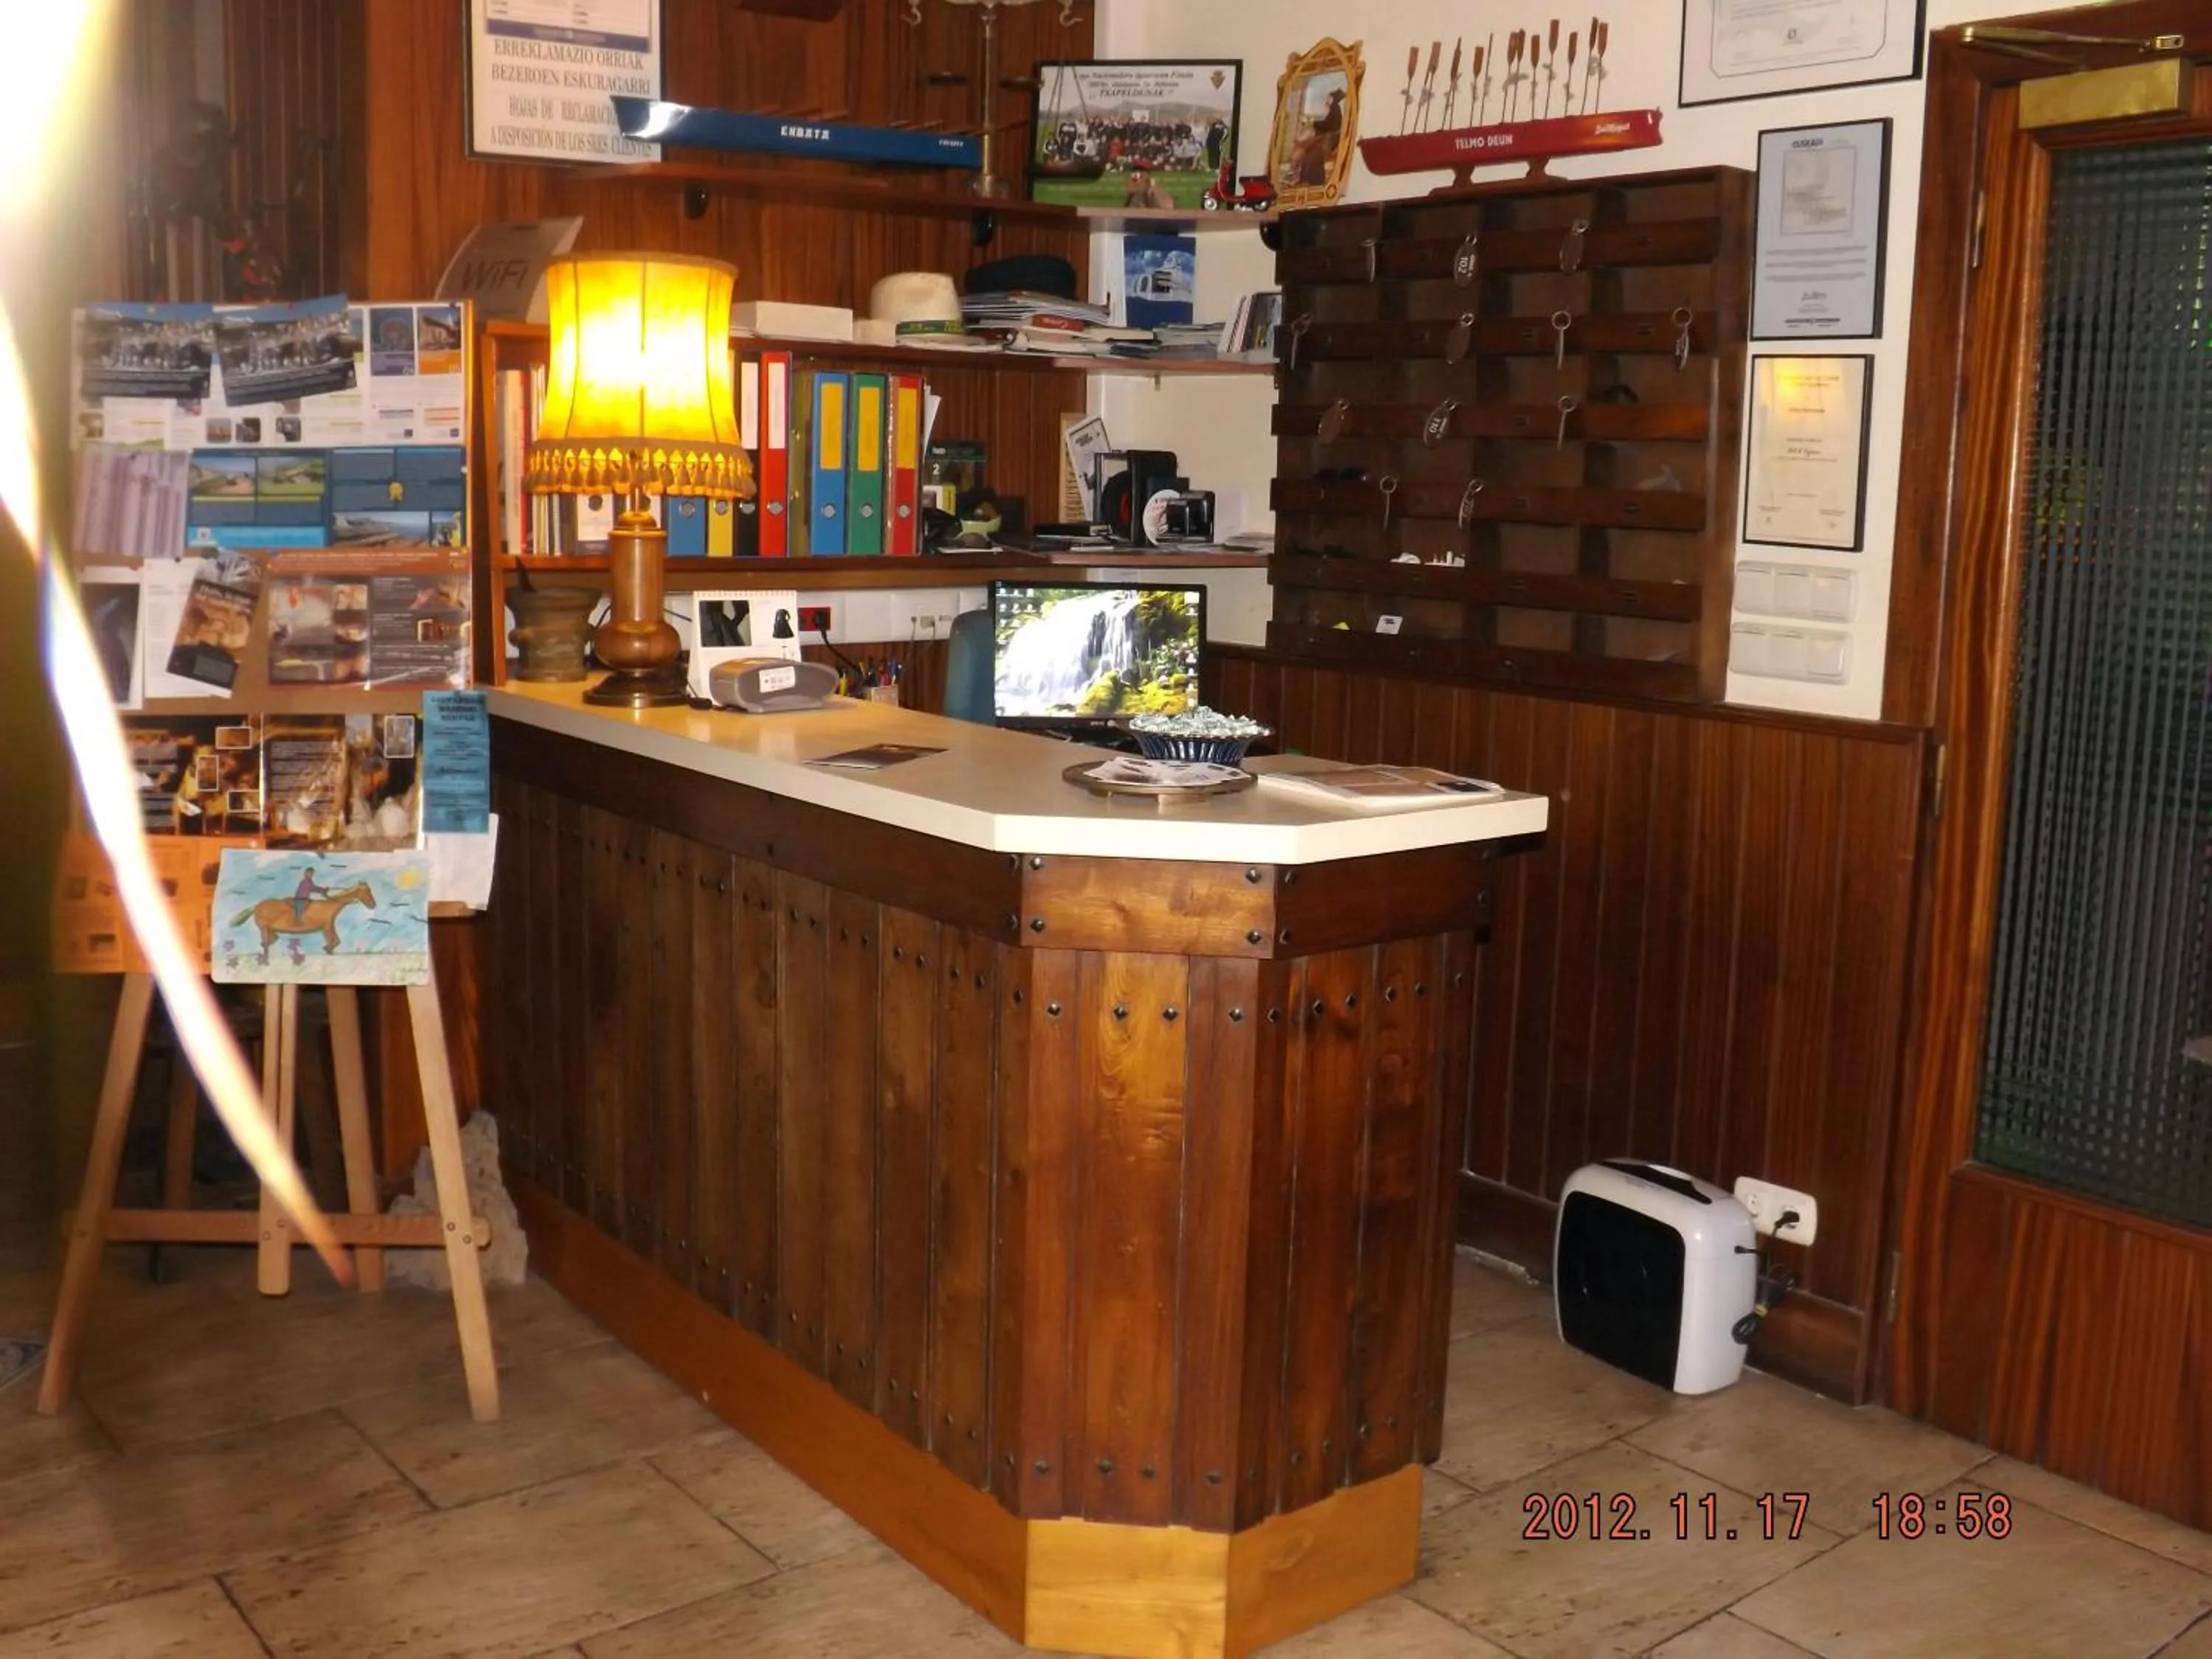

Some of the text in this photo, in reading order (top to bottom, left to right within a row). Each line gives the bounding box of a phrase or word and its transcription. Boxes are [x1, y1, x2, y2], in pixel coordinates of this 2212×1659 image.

[495, 38, 644, 70] ERREKLAMAZIO ORRIAK
[491, 63, 650, 95] BEZEROEN ESKURAGARRI
[541, 97, 553, 119] DE
[1455, 136, 1485, 150] TELMO
[932, 463, 940, 476] 2
